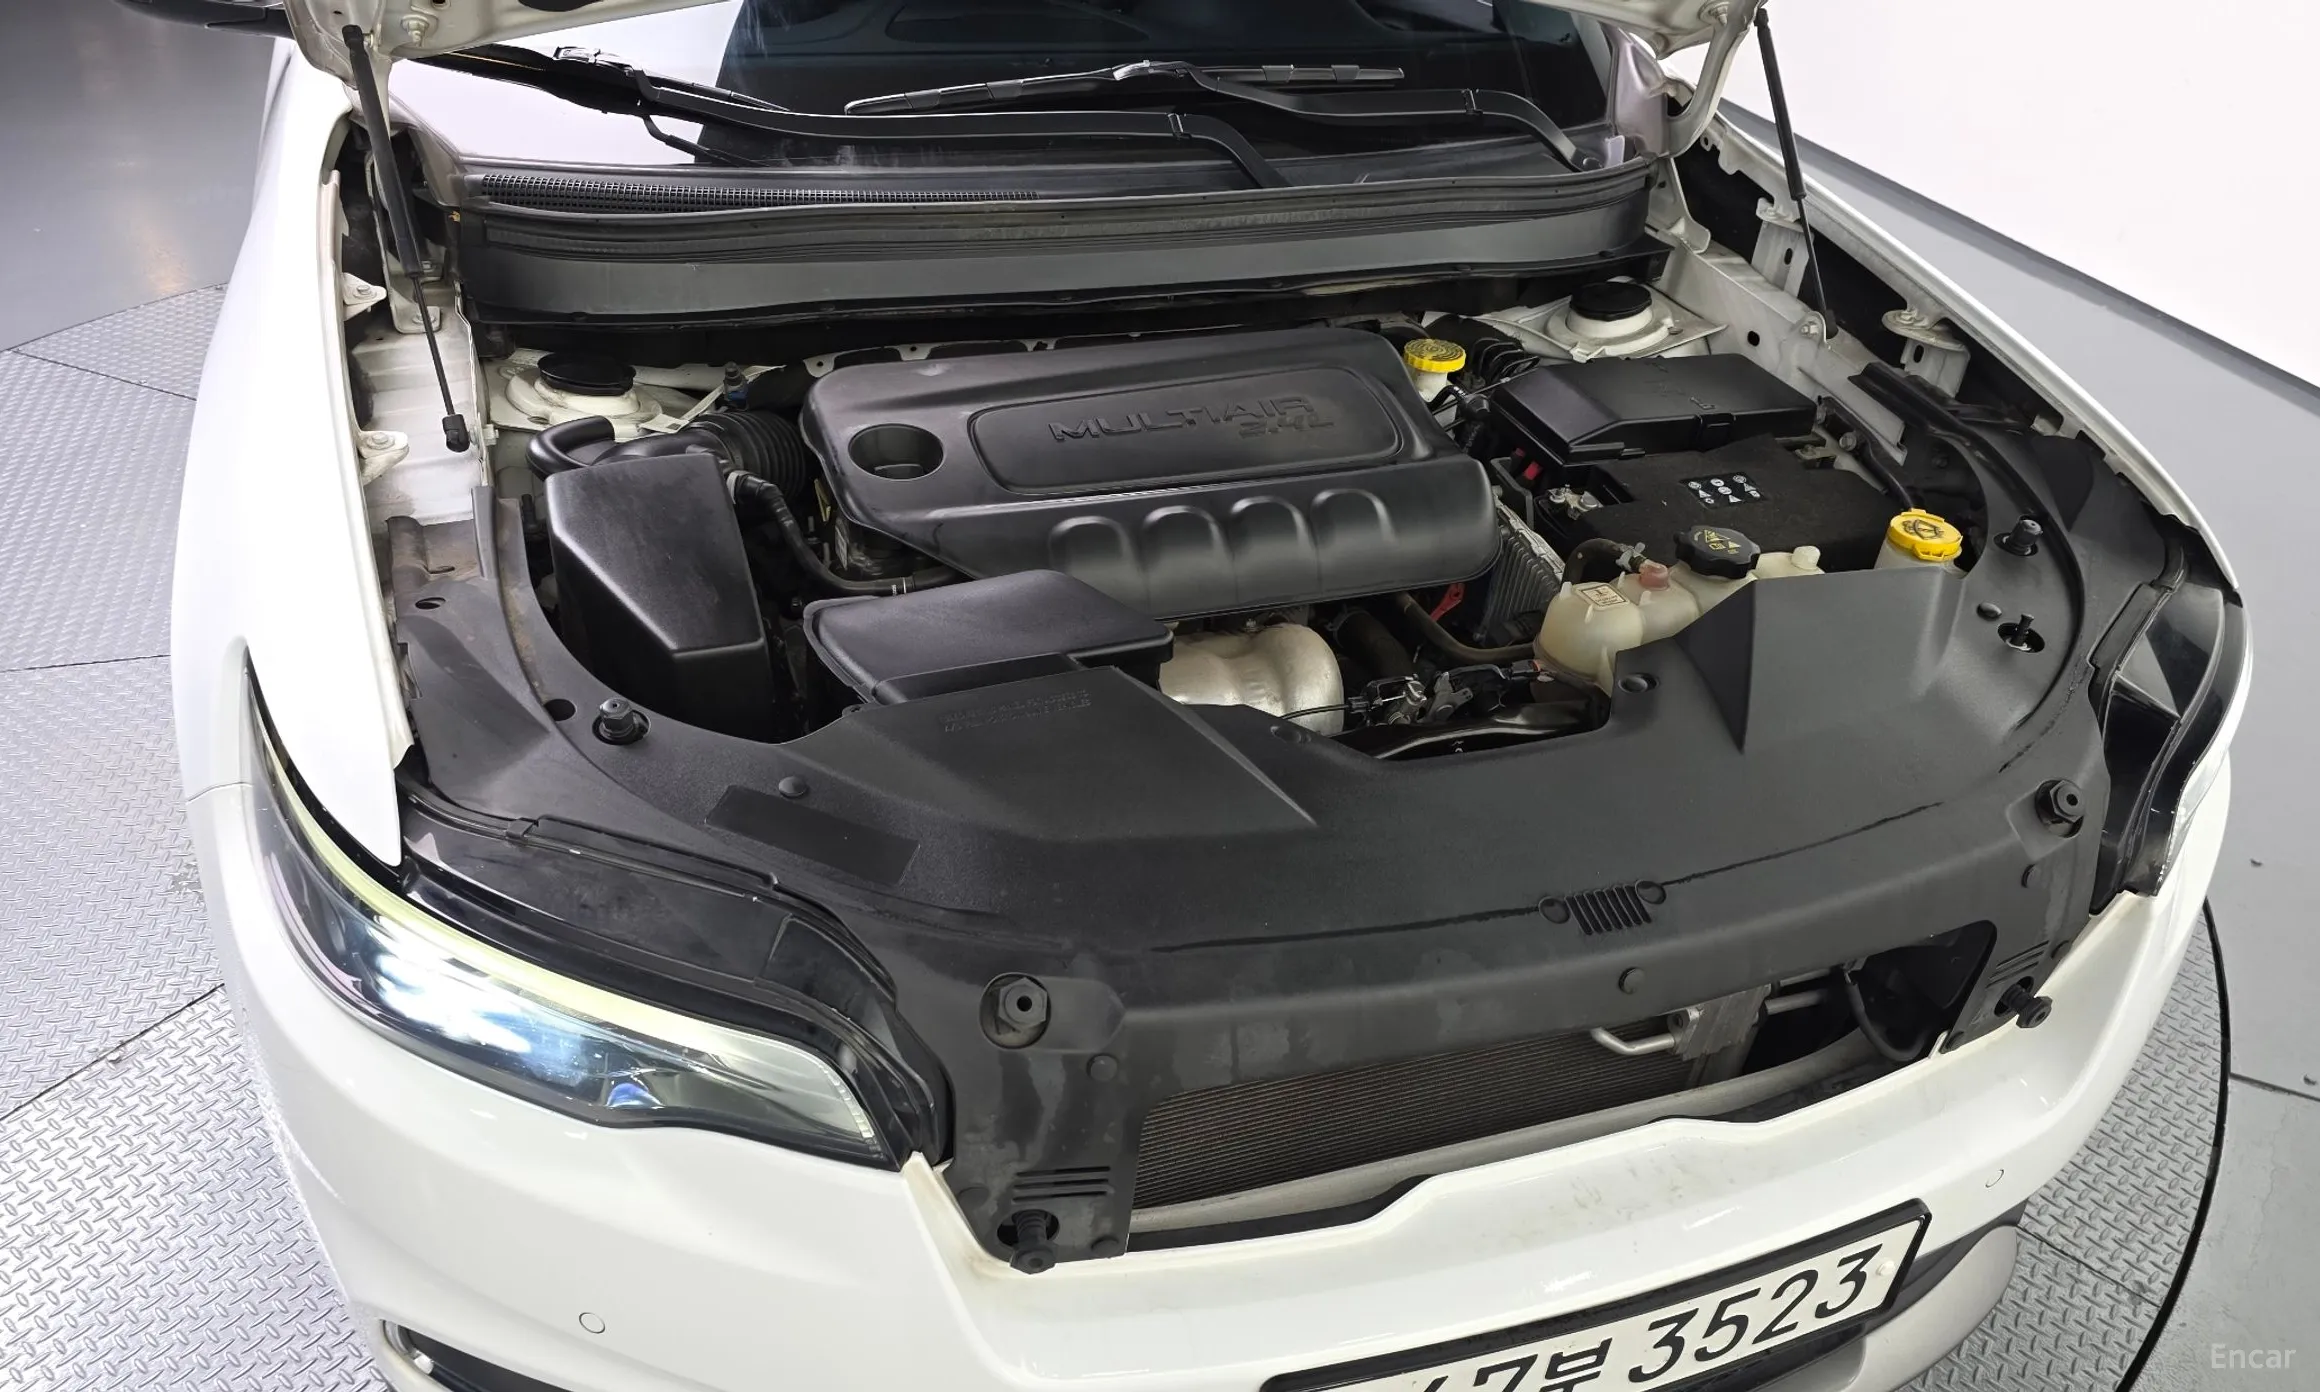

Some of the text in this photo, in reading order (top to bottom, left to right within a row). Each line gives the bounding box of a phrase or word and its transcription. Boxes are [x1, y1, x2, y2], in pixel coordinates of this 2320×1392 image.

[1049, 397, 1314, 442] MULTIAIR
[1424, 1243, 1883, 1392] 7부 3523
